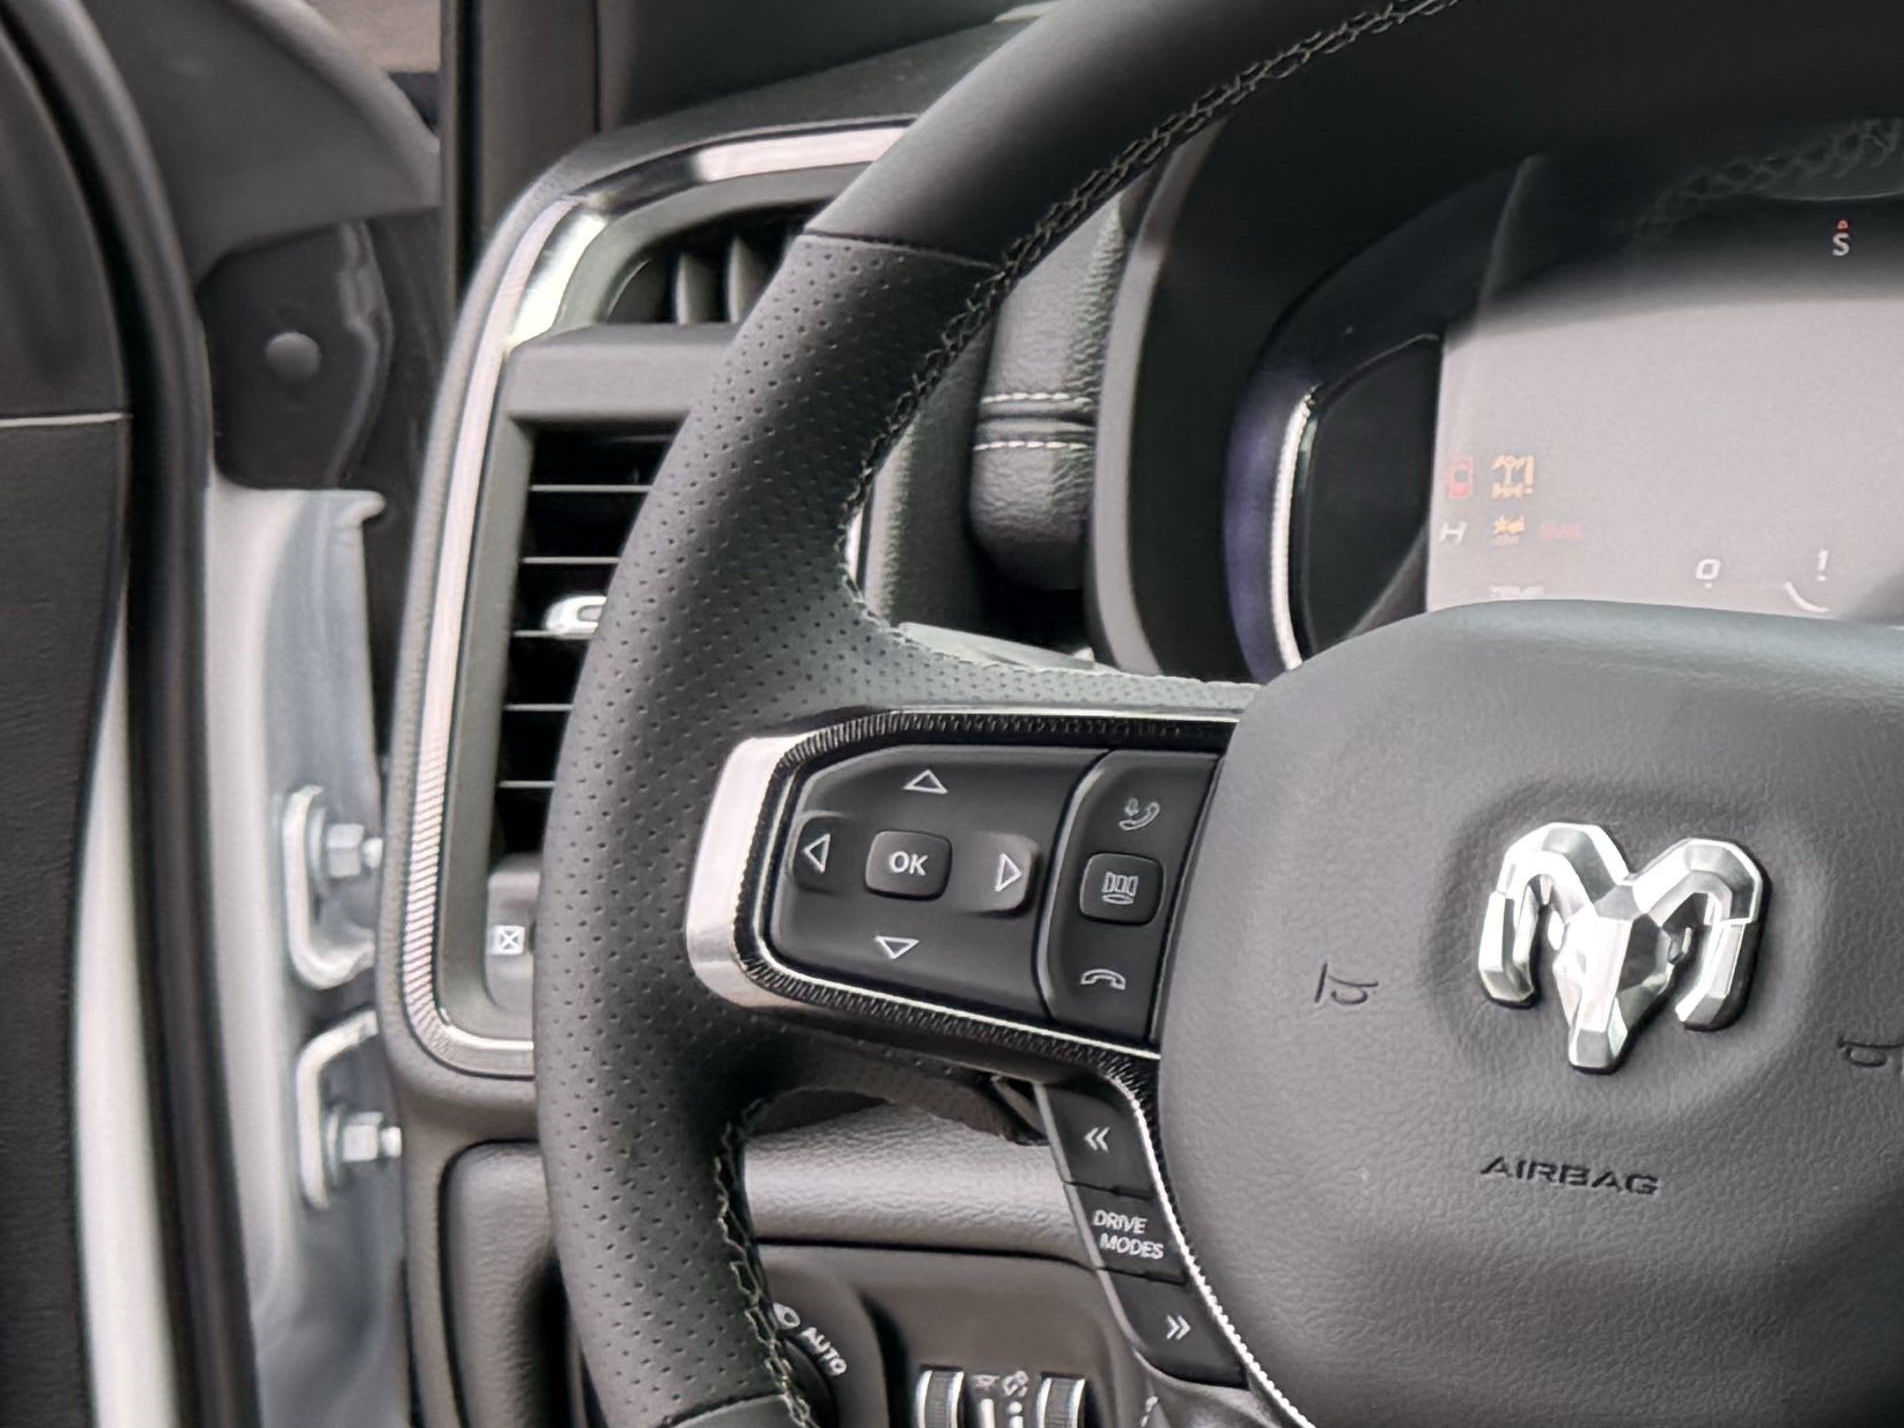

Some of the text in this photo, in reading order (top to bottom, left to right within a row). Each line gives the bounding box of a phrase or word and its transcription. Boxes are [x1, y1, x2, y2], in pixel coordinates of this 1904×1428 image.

[1440, 523, 1466, 543] H
[1696, 559, 1720, 580] 0
[1816, 551, 1828, 572] 1
[889, 851, 928, 876] OK
[1480, 1156, 1660, 1196] AIRBAG
[1093, 1209, 1147, 1234] DRIVE
[1100, 1233, 1164, 1259] MODES
[801, 1327, 847, 1376] AUTO
